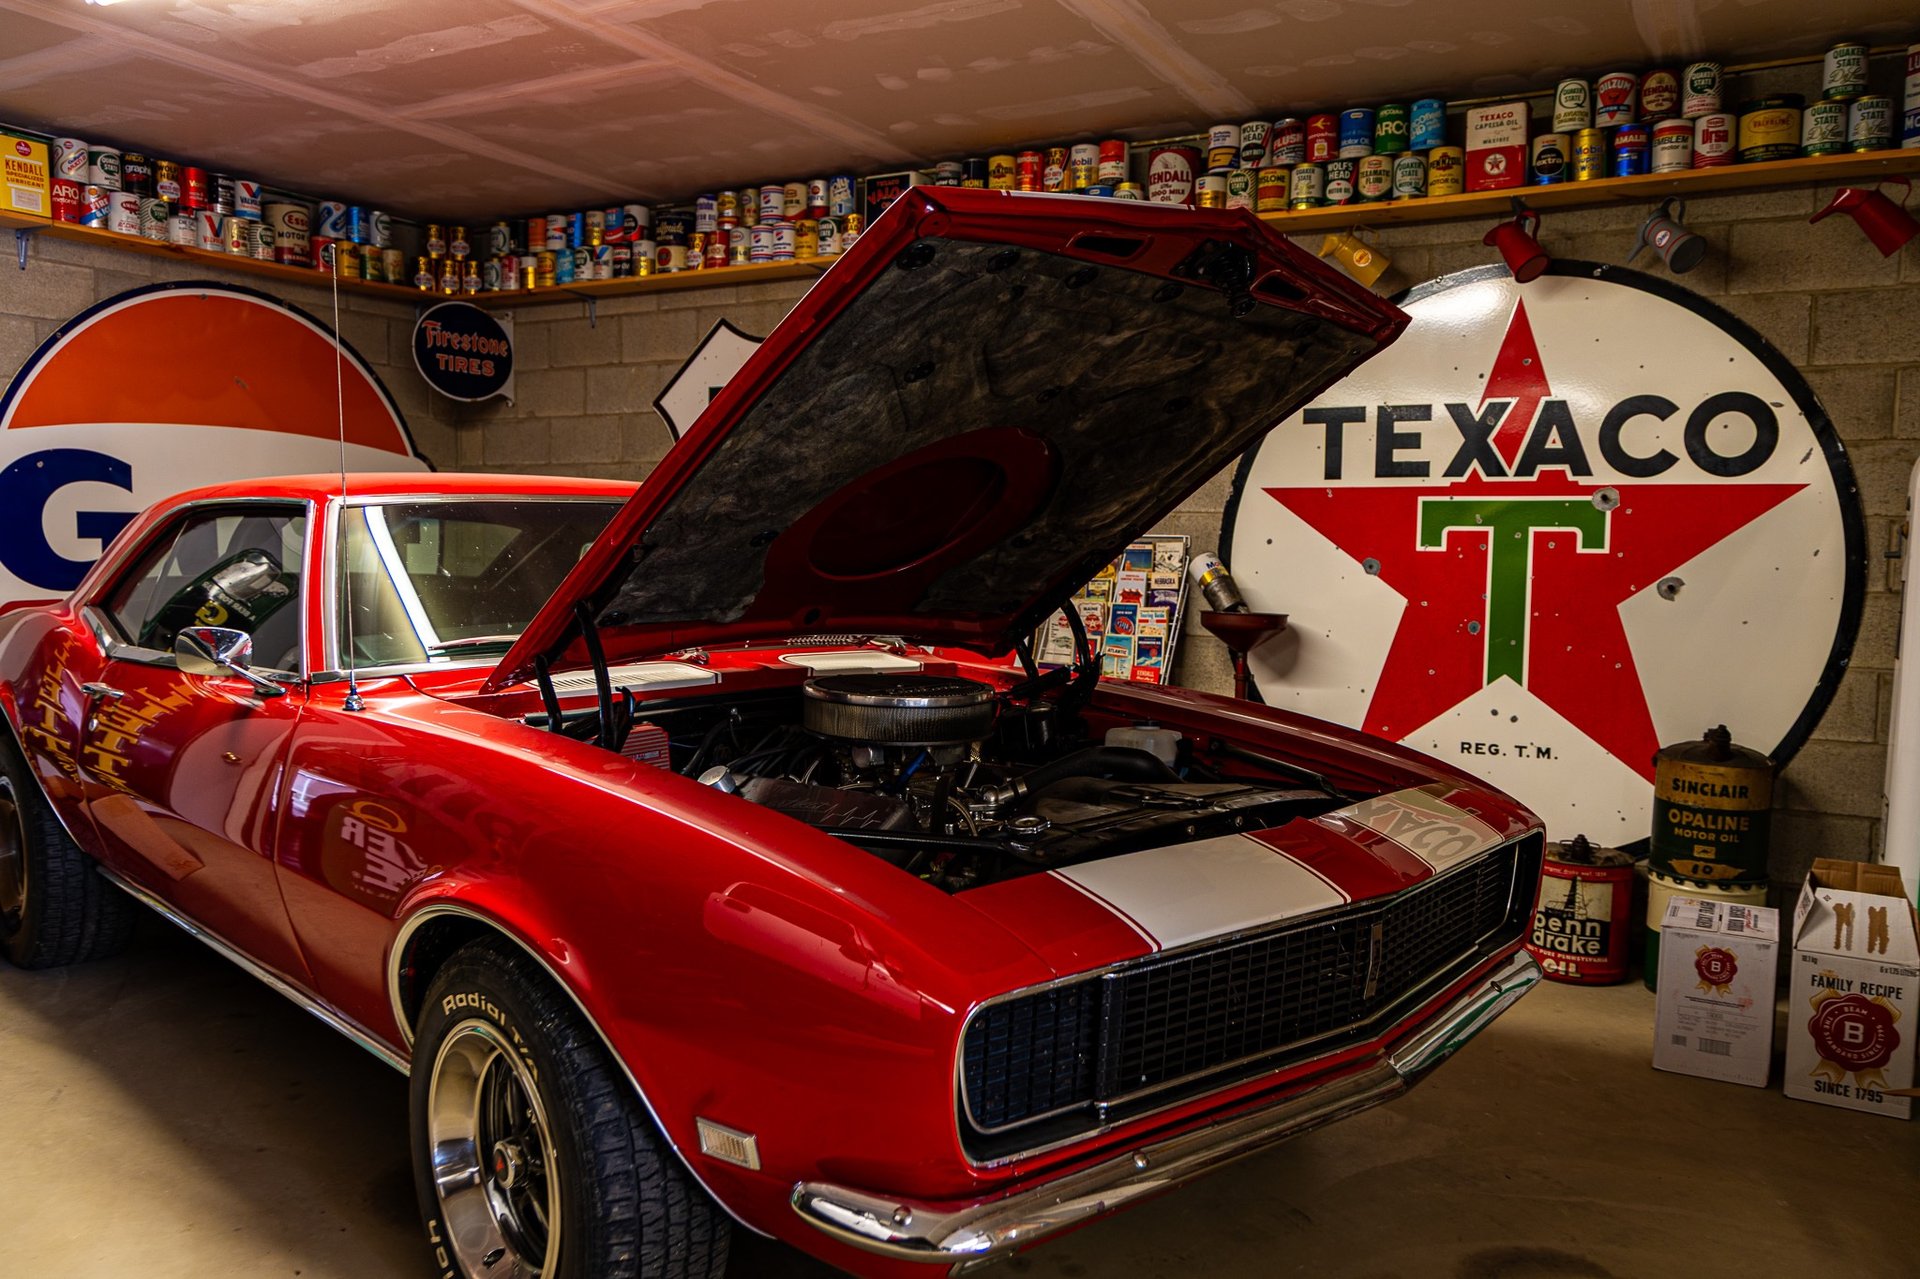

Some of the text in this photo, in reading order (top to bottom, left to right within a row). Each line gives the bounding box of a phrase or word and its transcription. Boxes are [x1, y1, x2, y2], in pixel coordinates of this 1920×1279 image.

[1833, 47, 1865, 59] QUAKER
[1837, 58, 1860, 68] STATE
[1600, 78, 1631, 93] OILZUM
[1694, 79, 1712, 87] STATE
[1811, 105, 1842, 116] QUAKER
[1857, 99, 1889, 111] QUAKER
[1479, 111, 1514, 122] TEXACO
[1814, 116, 1838, 126] STATE
[1861, 111, 1885, 121] STATE
[1242, 125, 1266, 134] WOLF'S
[1243, 133, 1263, 142] HEAD
[1653, 136, 1689, 147] EMBLEM
[5, 158, 44, 177] KENDALL
[1071, 157, 1093, 167] Mobil
[1328, 160, 1353, 171] WOLF'S
[1536, 157, 1563, 166] extra
[103, 164, 120, 173] STATE
[6, 170, 45, 183] SPECIALIZED
[1149, 171, 1191, 184] KENDALL
[1329, 170, 1351, 180] HEAD
[6, 176, 45, 190] LUBRICANT
[1231, 182, 1245, 190] STATE
[277, 231, 306, 241] MOTOR
[422, 319, 509, 358] Firestone
[436, 353, 496, 377] TIRES
[1303, 391, 1779, 479] TEXACO
[1107, 647, 1127, 655] ATLANTIC
[1460, 742, 1507, 756] REG.
[1672, 778, 1749, 799] SINCLAIR
[1668, 808, 1751, 832] OPALINE
[1674, 827, 1741, 843] MOTOR OIL
[1533, 913, 1601, 937] penn
[1532, 929, 1601, 956] drake
[1542, 958, 1582, 978] OIL
[1711, 961, 1721, 972] B
[1811, 974, 1903, 1000] FAMILY RECIPE
[442, 992, 506, 1026] Radial
[1843, 1006, 1868, 1015] BEAM
[1843, 1021, 1865, 1044] B
[1861, 1043, 1883, 1059] SINCE
[1814, 1079, 1884, 1104] SINCE 1795
